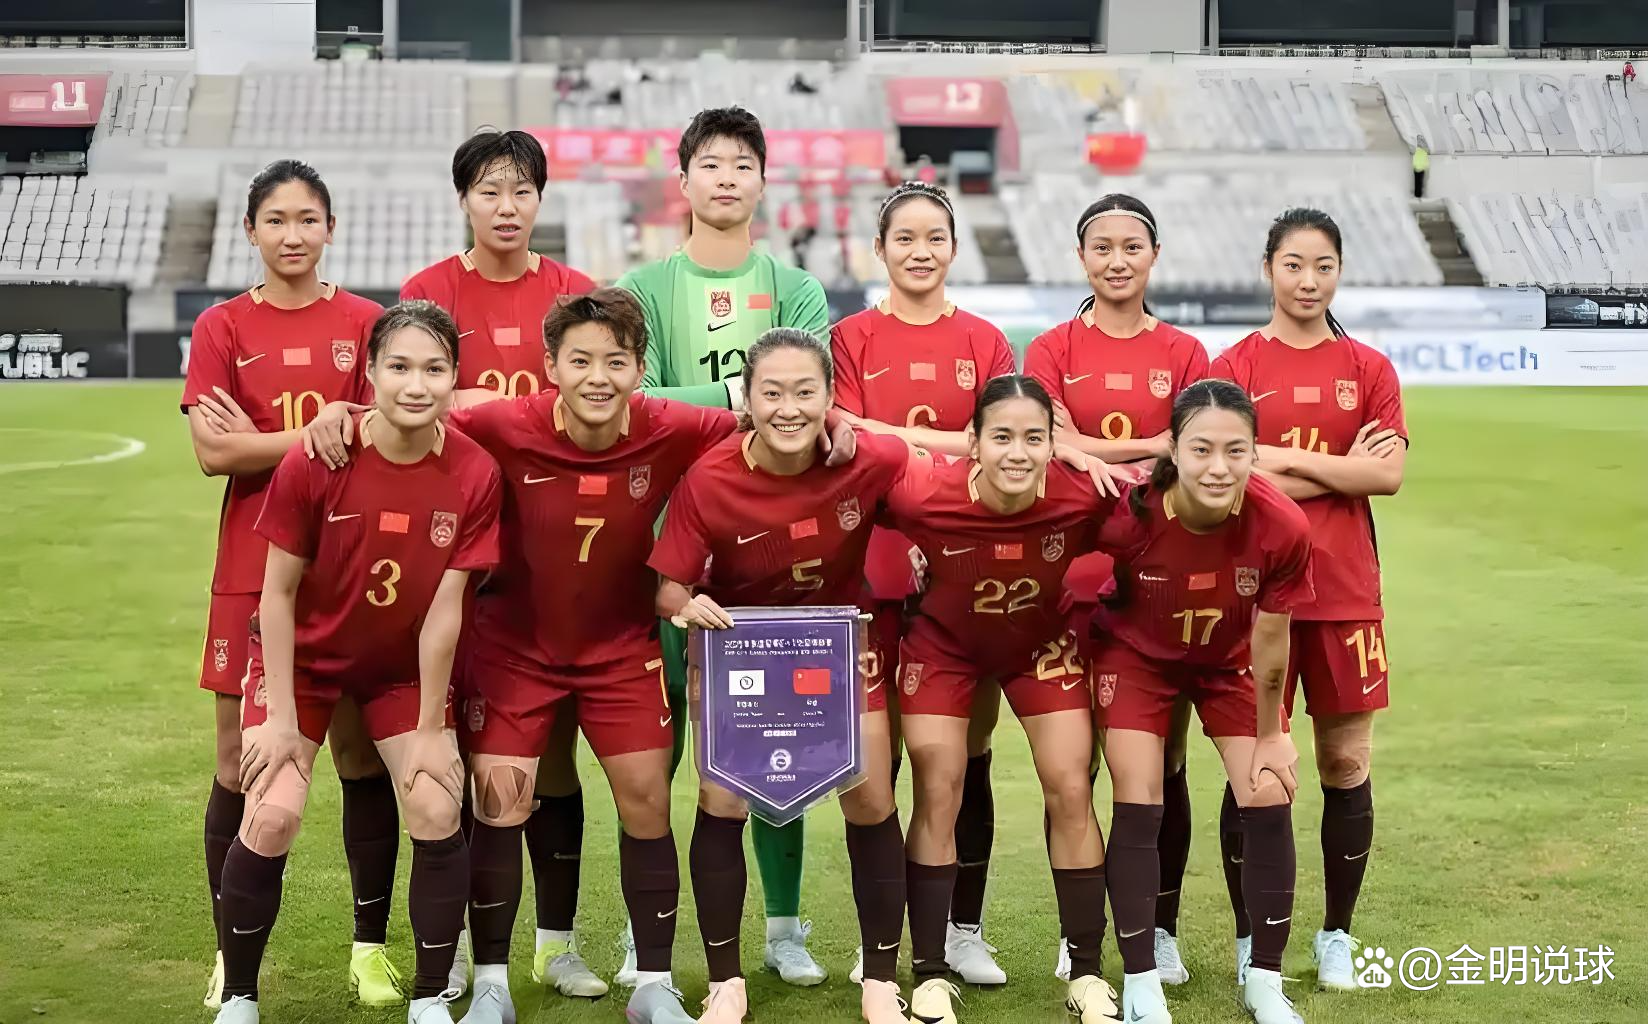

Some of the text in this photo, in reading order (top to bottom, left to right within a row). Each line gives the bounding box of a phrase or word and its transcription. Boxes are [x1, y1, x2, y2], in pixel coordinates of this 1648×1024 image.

[699, 348, 747, 383] 12
[271, 390, 327, 432] 10
[574, 516, 606, 563] 7
[366, 558, 401, 606] 3
[791, 557, 824, 591] 5
[974, 577, 1040, 614] 22
[1172, 608, 1223, 647] 17
[1345, 625, 1388, 678] 14
